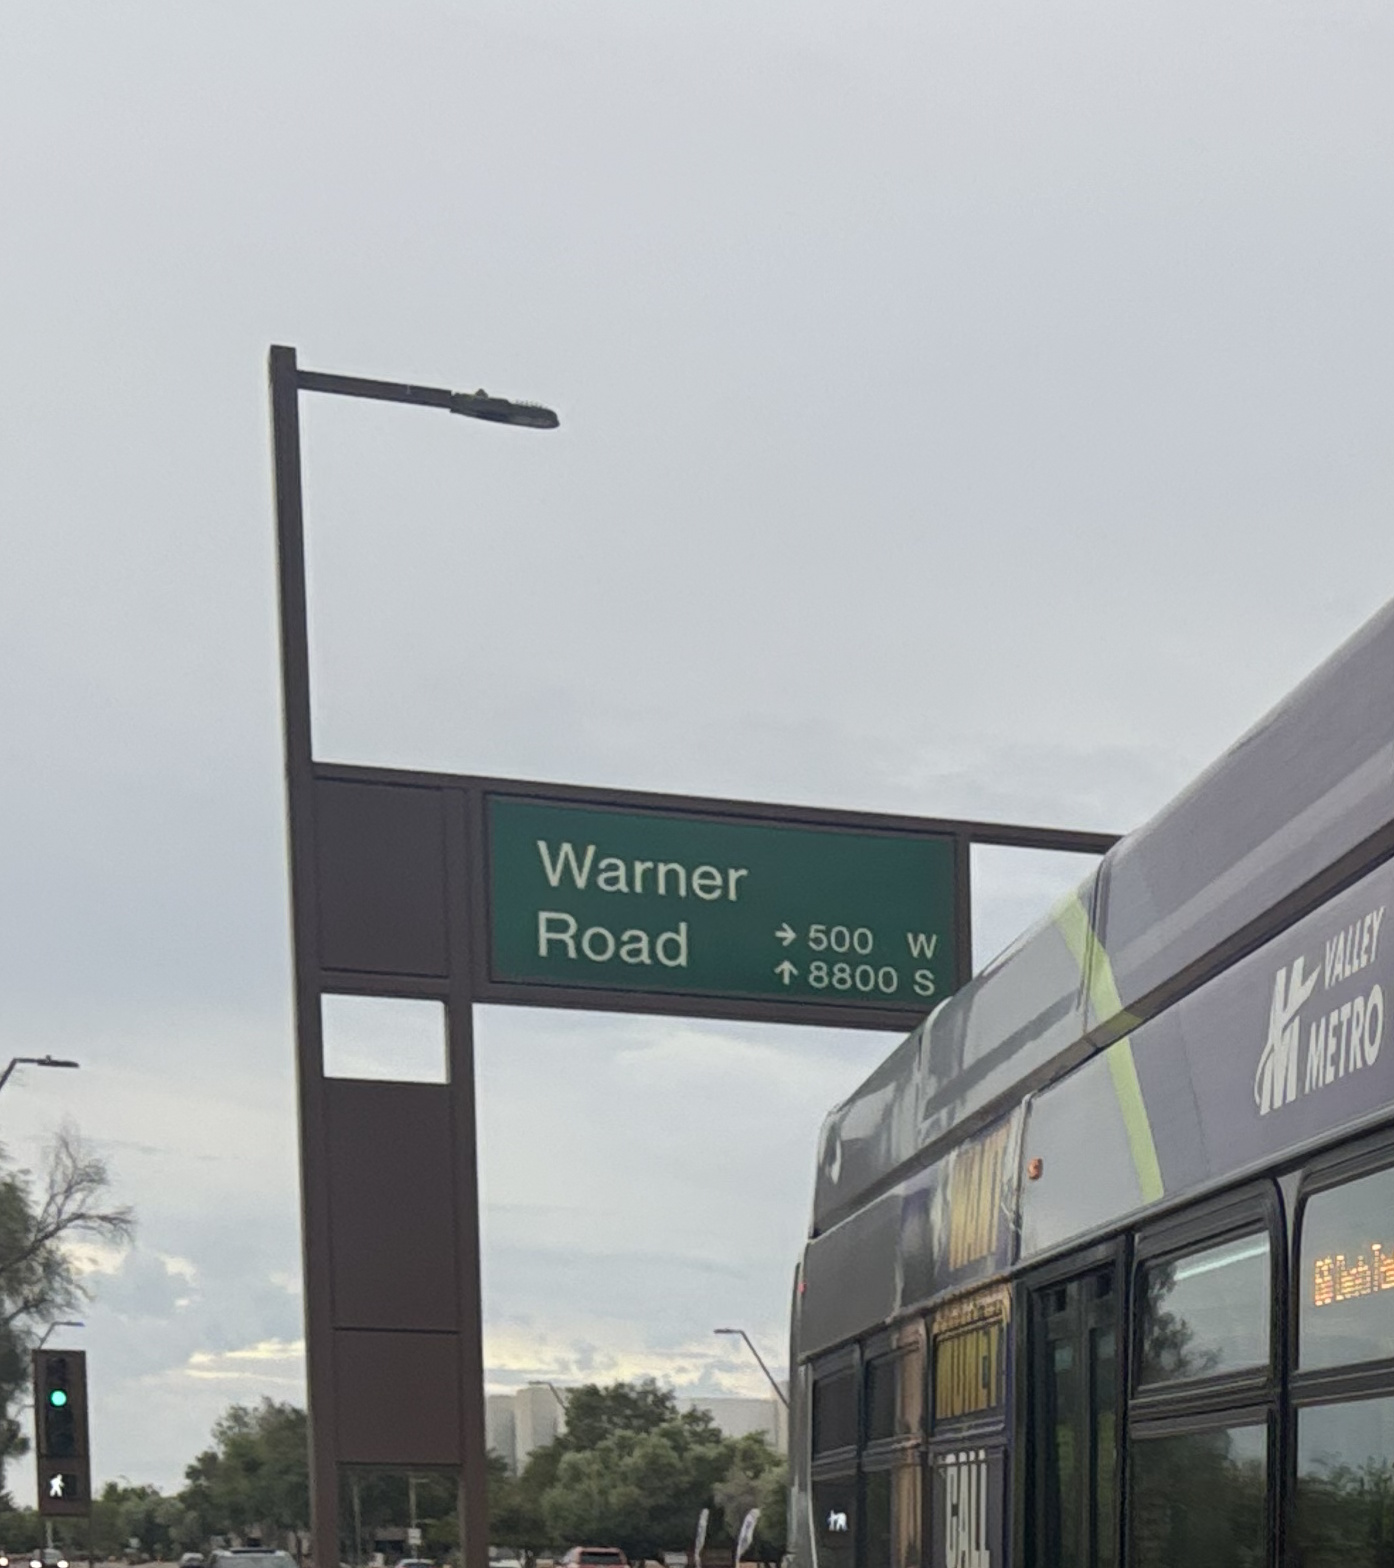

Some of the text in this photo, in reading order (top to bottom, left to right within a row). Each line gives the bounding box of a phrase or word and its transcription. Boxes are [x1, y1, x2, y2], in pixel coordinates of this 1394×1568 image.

[536, 840, 748, 902] Warner
[536, 911, 689, 968] Road
[808, 925, 938, 959] 500 W
[1324, 905, 1386, 990] VALLEY
[808, 960, 936, 996] 8800 S
[1304, 984, 1384, 1094] METRO
